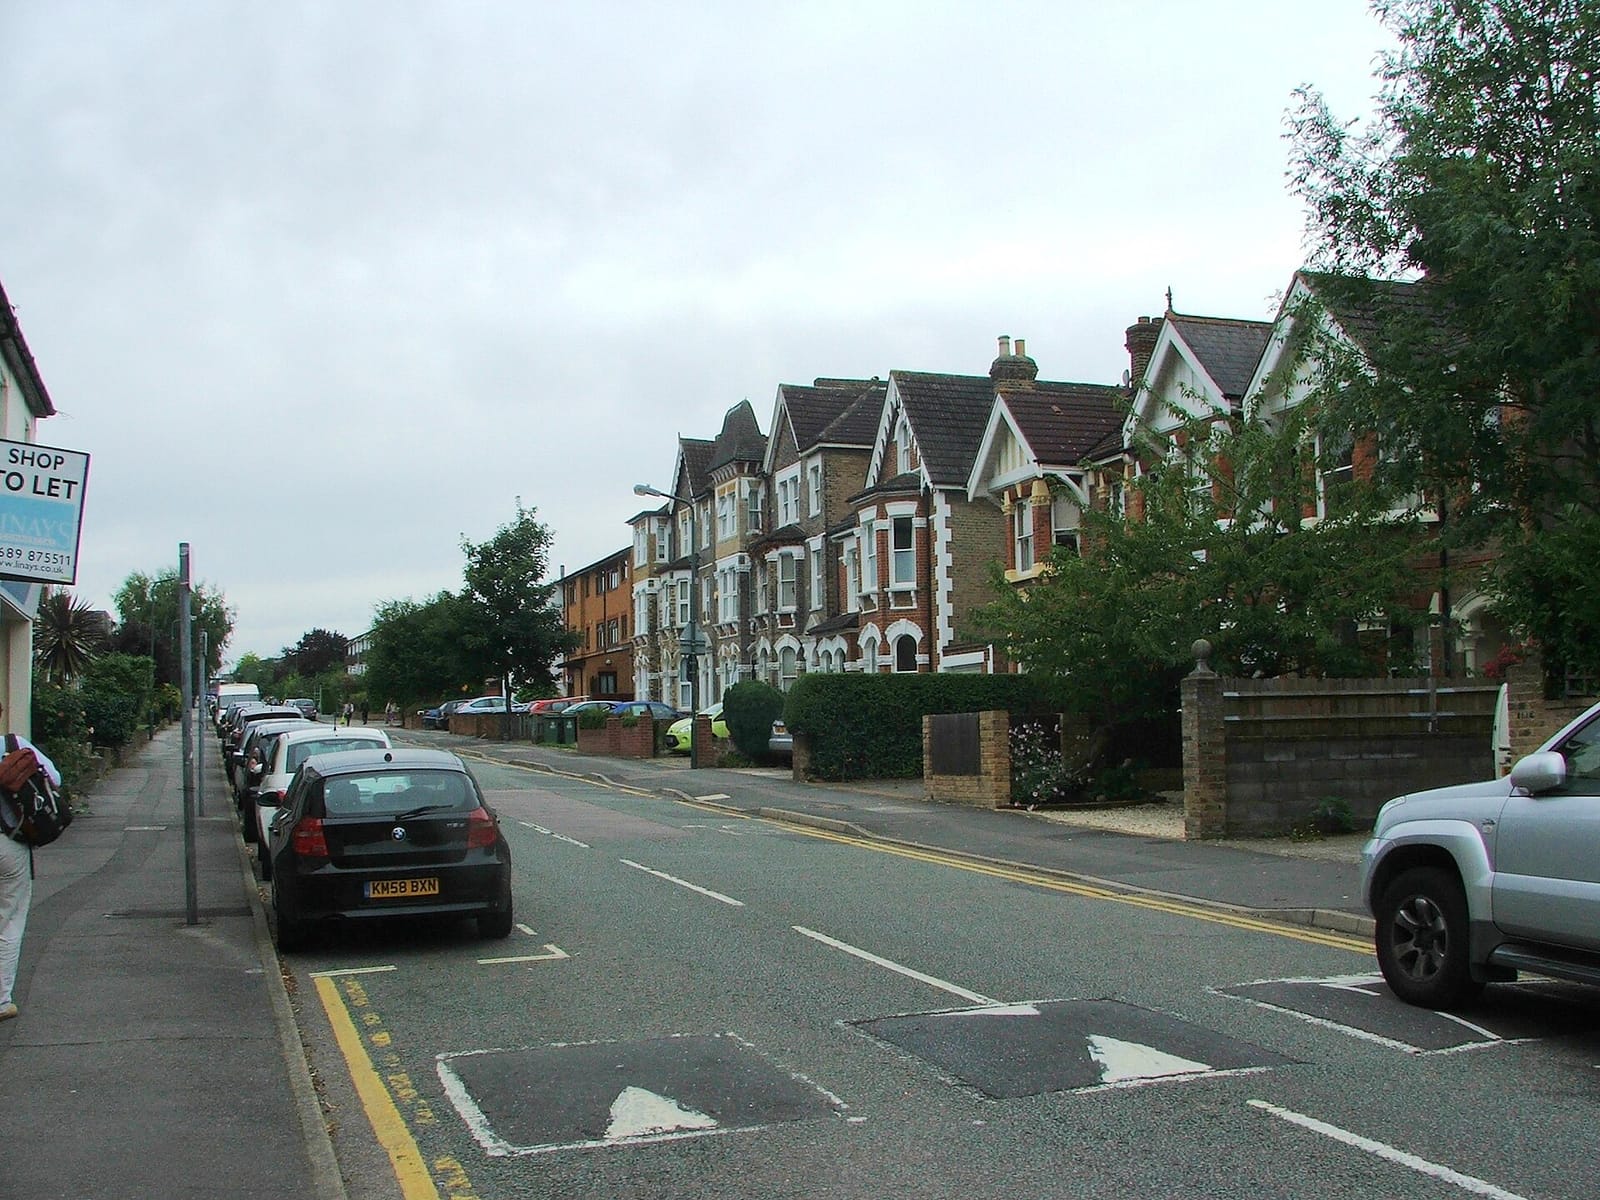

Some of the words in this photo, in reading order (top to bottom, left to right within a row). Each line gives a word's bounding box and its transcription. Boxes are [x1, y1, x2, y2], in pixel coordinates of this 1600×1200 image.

[8, 448, 65, 471] SHOP
[32, 475, 78, 500] LET
[28, 550, 71, 566] 875511
[372, 881, 407, 895] KM58
[411, 879, 436, 892] BXN
